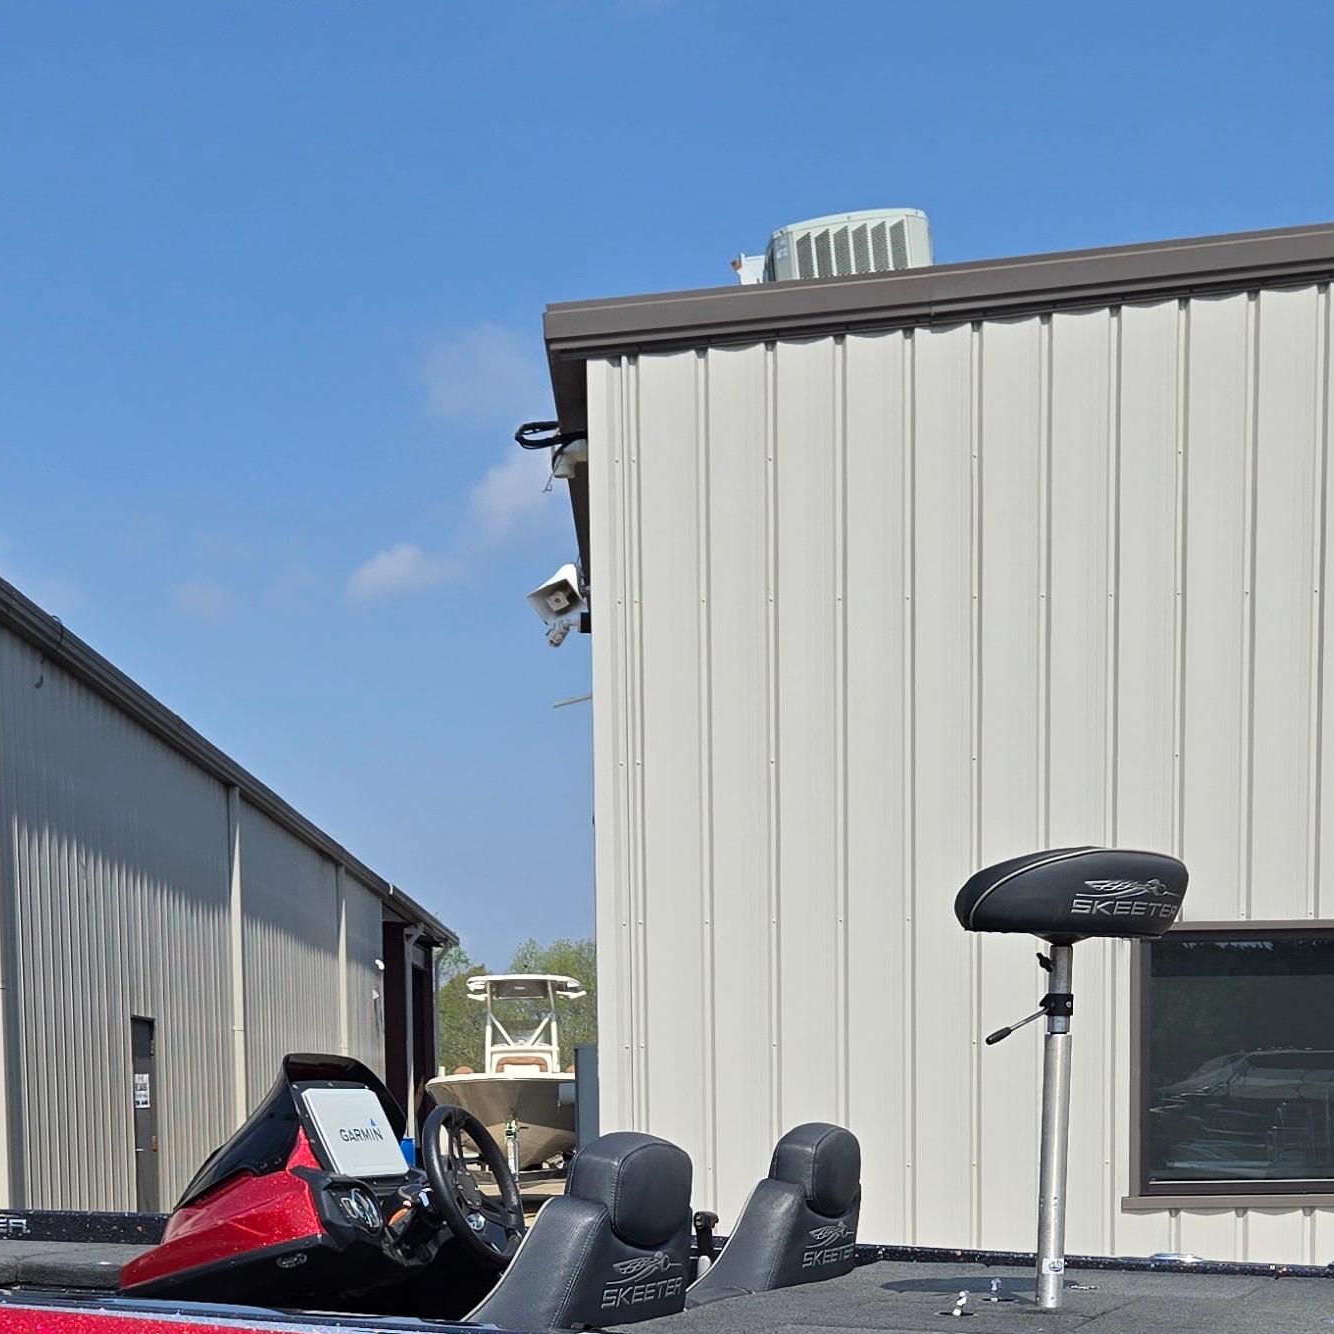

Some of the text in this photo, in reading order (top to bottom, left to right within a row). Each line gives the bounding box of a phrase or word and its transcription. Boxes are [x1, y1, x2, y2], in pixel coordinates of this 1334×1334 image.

[1070, 899, 1178, 919] SKEETER
[339, 1127, 384, 1142] GARMIN
[600, 1276, 683, 1310] SKEETER
